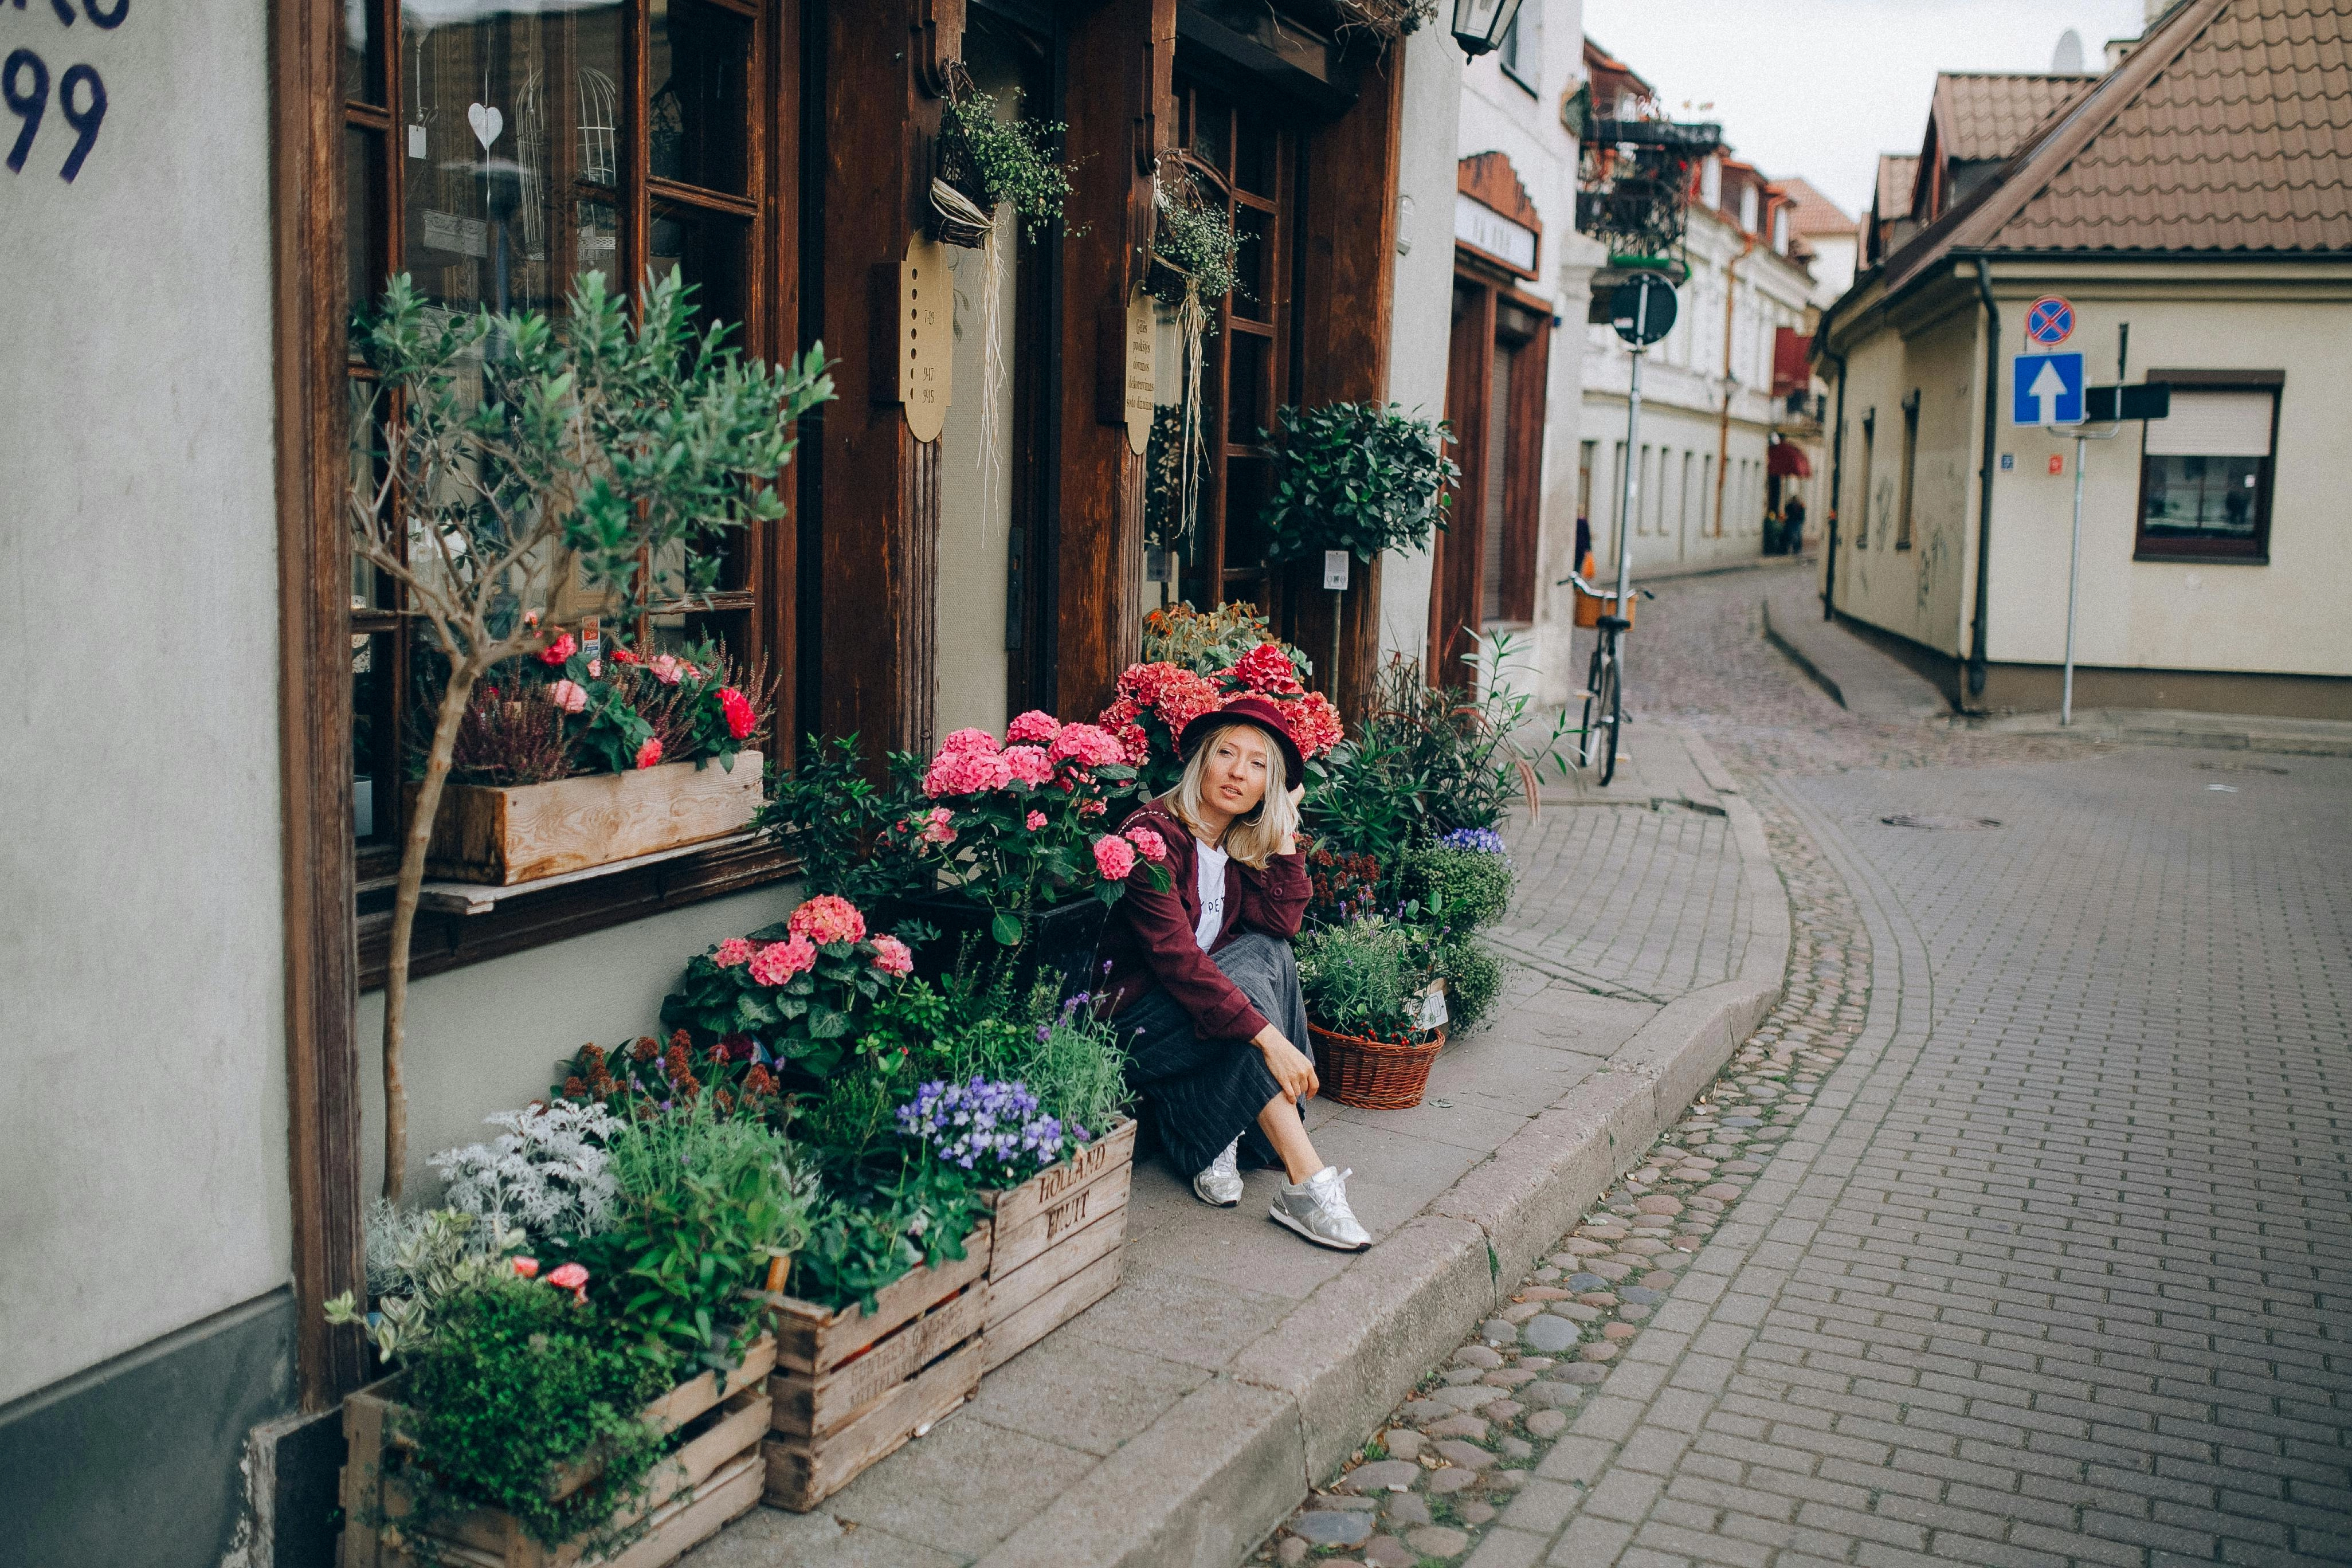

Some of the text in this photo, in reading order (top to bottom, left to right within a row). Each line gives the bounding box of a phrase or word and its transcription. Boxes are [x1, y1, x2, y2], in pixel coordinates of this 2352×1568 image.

[923, 367, 934, 381] 9-17
[922, 389, 934, 403] 9-15
[1036, 1143, 1105, 1204] HOLLAND
